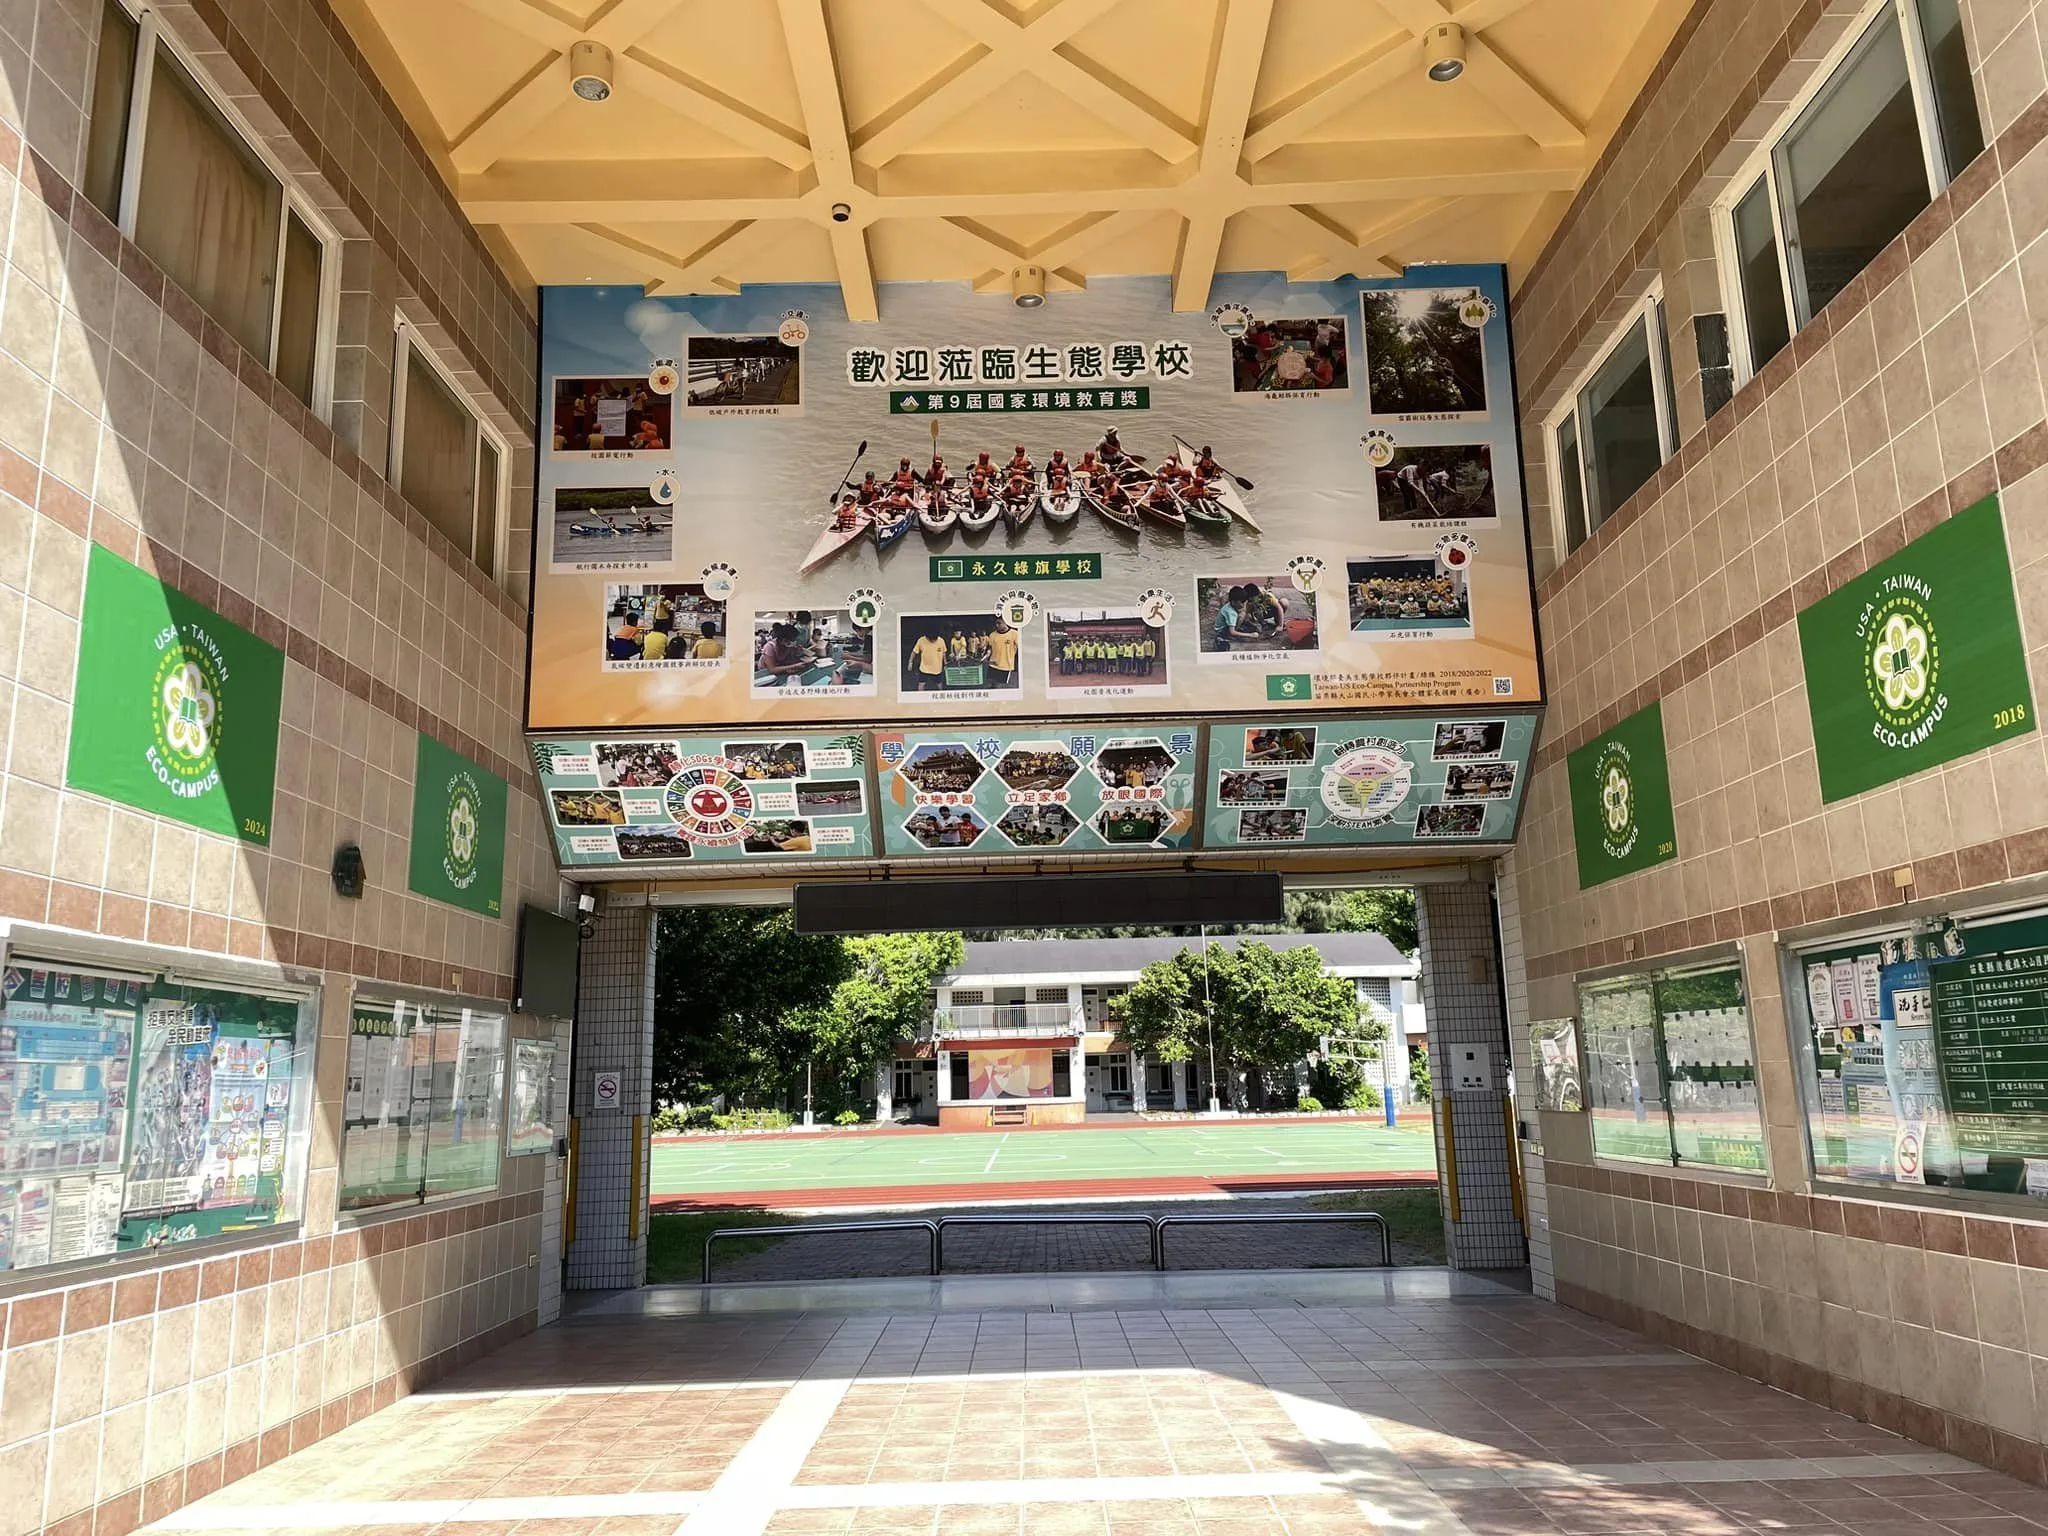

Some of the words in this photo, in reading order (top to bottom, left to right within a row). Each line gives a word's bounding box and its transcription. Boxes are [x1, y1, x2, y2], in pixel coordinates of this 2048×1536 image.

[850, 343, 1191, 384] 歡迎蒞臨生態學校
[927, 389, 1139, 411] 第9屆國家環境教育獎
[971, 558, 1093, 577] 永久綠旗學校
[1856, 601, 1875, 638] USA
[1883, 574, 1933, 600] TAIWAN
[154, 623, 178, 651] USA
[190, 623, 230, 682] TAIWAN
[1872, 693, 1949, 749] ECO-CAMPUS
[1993, 703, 2026, 730] 2018
[880, 733, 1194, 763] 學校願景
[1594, 755, 1605, 779] USA
[1607, 740, 1631, 763] TAIWAN
[145, 745, 220, 799] ECO-CAMPUS
[447, 773, 459, 793] USA
[463, 771, 482, 808] TAIWAN
[914, 793, 974, 805] 快樂學習
[1007, 791, 1067, 803] 立足家鄉
[1101, 787, 1164, 801] 放眼國際
[244, 818, 266, 837] 2024
[1602, 824, 1639, 860] ECO-CAMPUS
[443, 856, 477, 890] ECO-CAMPUS
